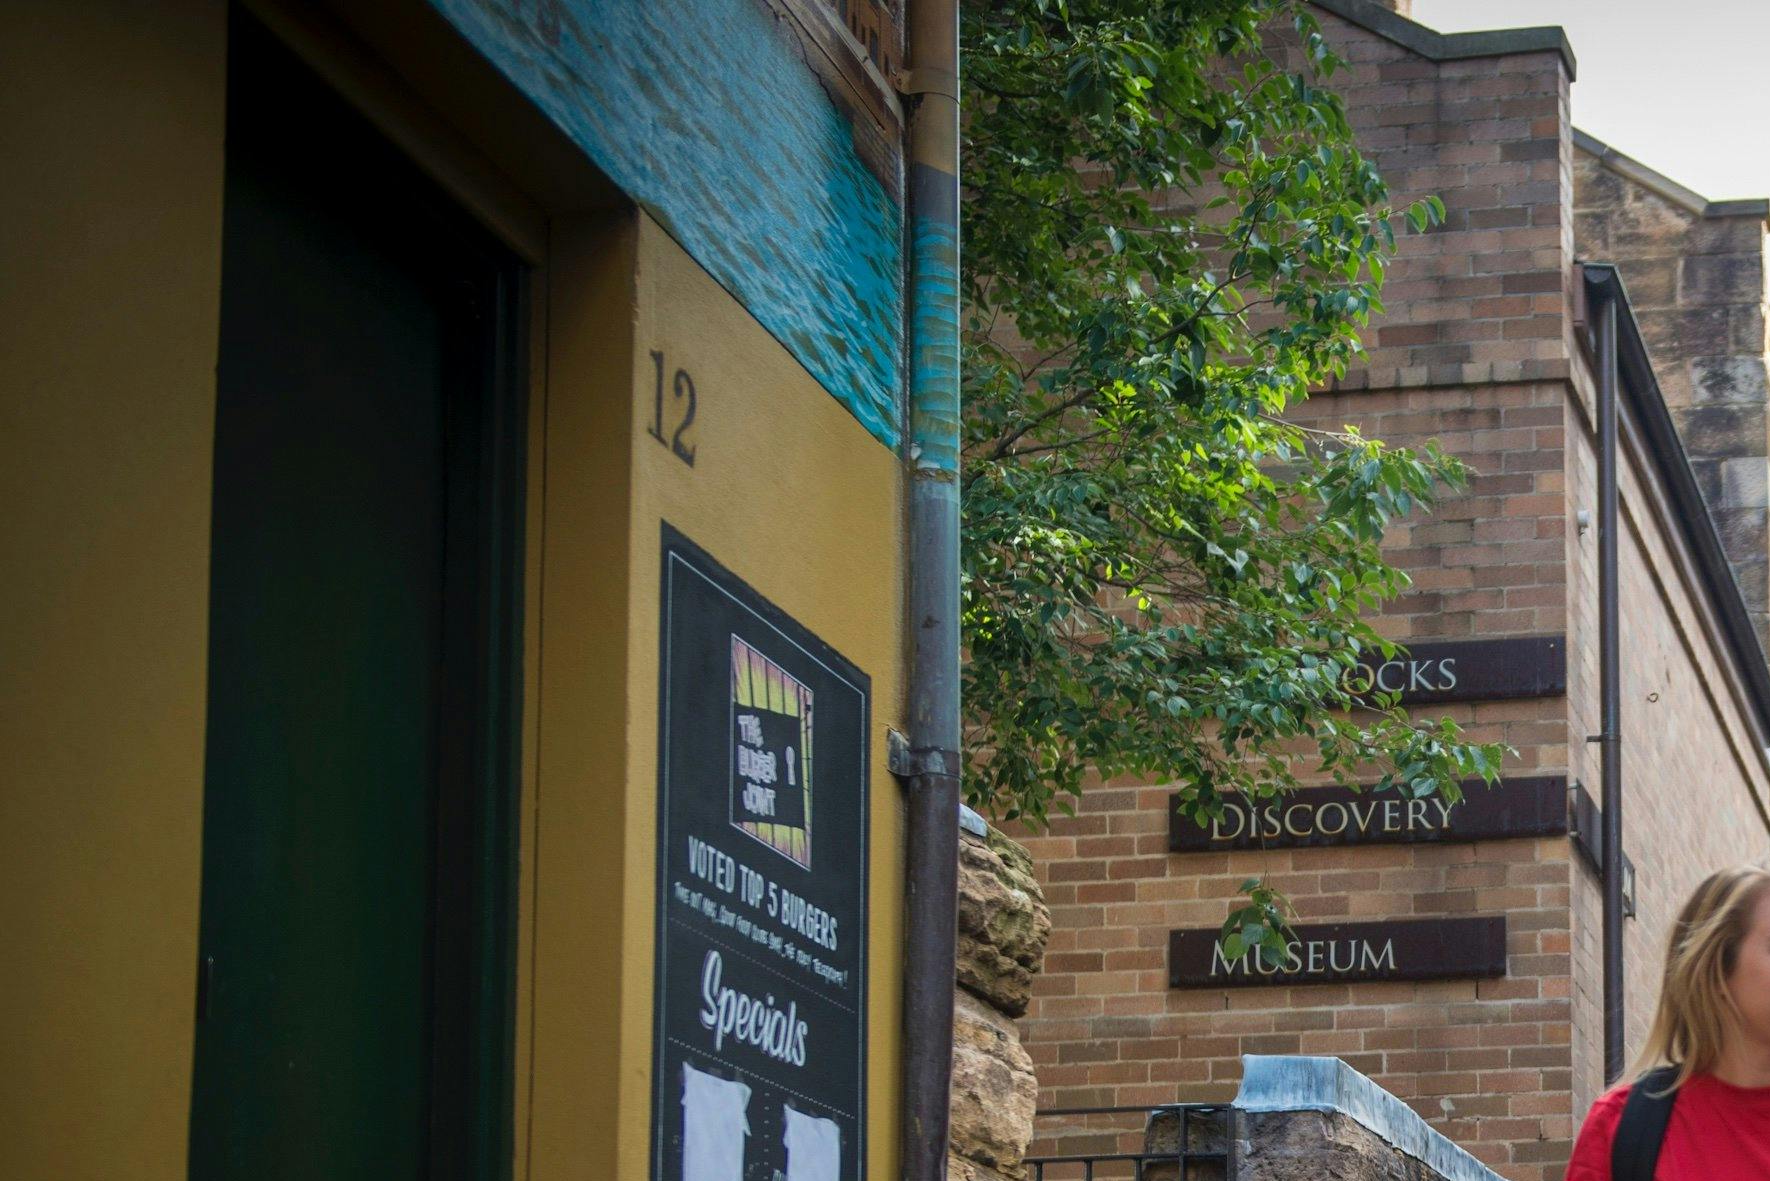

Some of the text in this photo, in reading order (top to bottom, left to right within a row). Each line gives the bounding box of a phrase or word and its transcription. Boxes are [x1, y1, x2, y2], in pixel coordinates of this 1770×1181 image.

[647, 349, 697, 468] 12
[1340, 658, 1457, 695] OCKS
[1211, 798, 1456, 841] DISCOVERY
[688, 835, 735, 894] VOTED
[739, 864, 765, 909] TOP
[767, 881, 778, 918] 5
[781, 888, 838, 951] BURGERS
[1209, 938, 1397, 977] MUSEUM
[701, 950, 808, 1067] Specials
